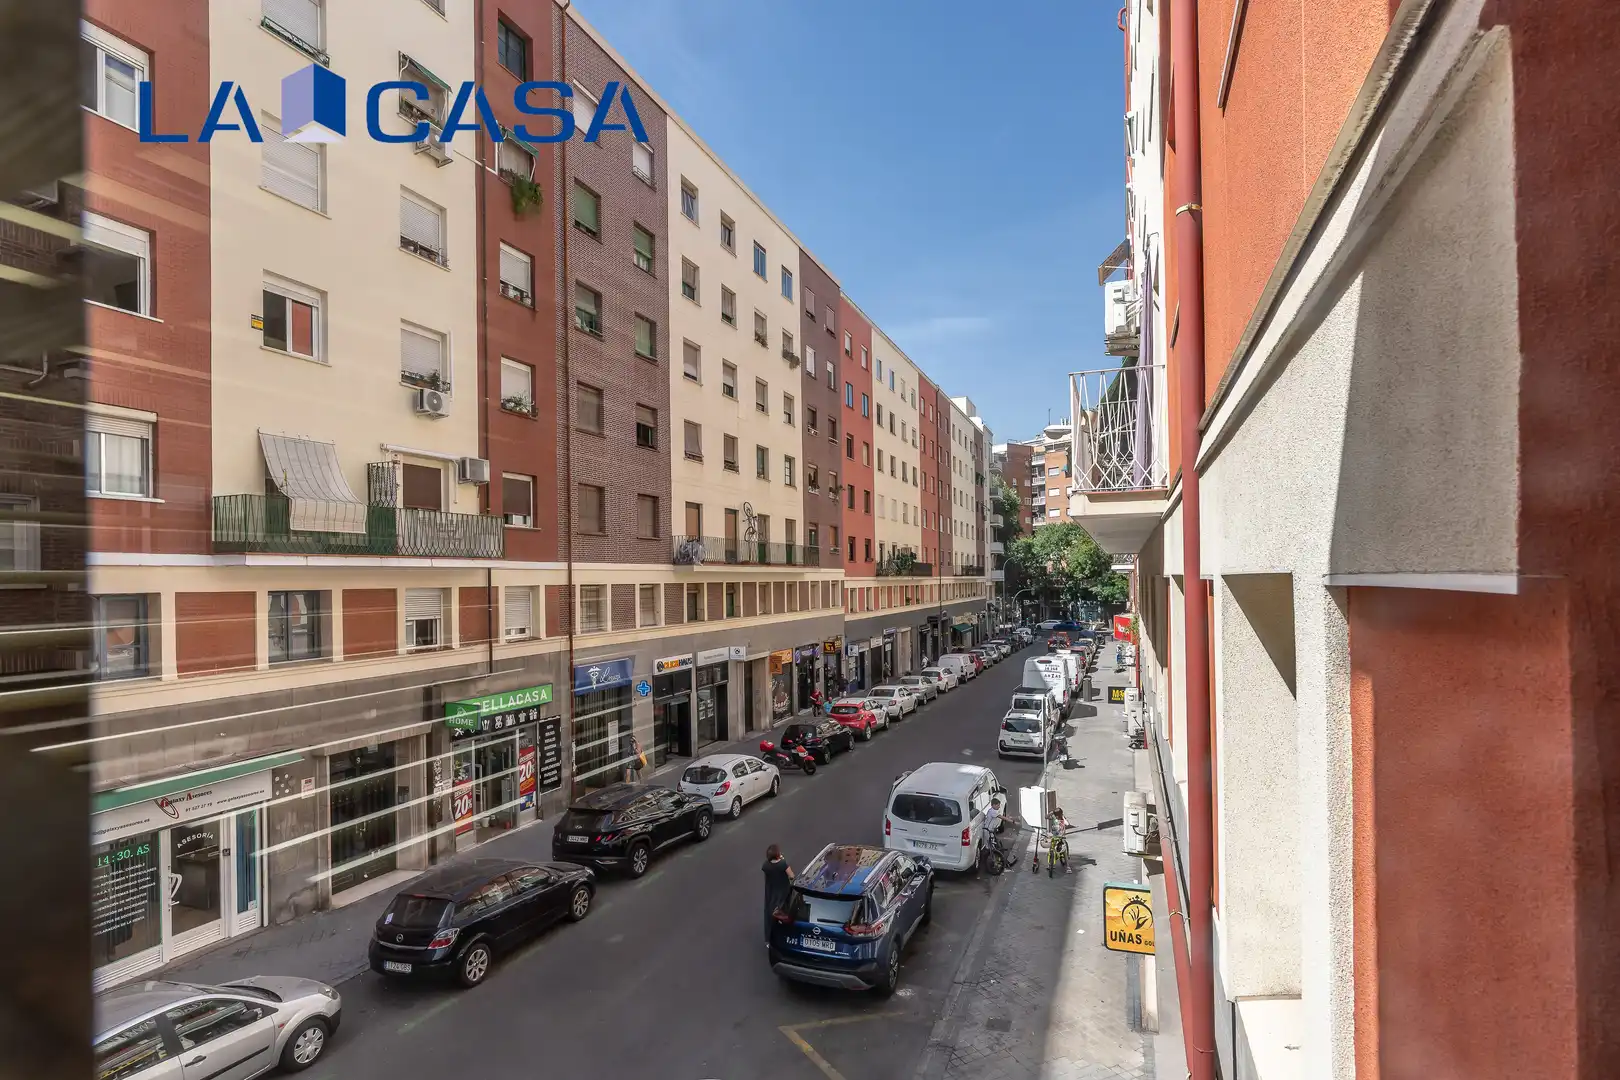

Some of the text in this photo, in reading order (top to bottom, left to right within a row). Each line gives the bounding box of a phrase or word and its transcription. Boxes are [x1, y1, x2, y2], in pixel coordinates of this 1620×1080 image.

[473, 689, 548, 712] ELLACASA
[449, 716, 474, 726] HOME
[186, 790, 213, 801] Asesores
[177, 832, 214, 849] ASESORÍA
[136, 844, 150, 856] AS
[1110, 929, 1142, 945] UÑAS
